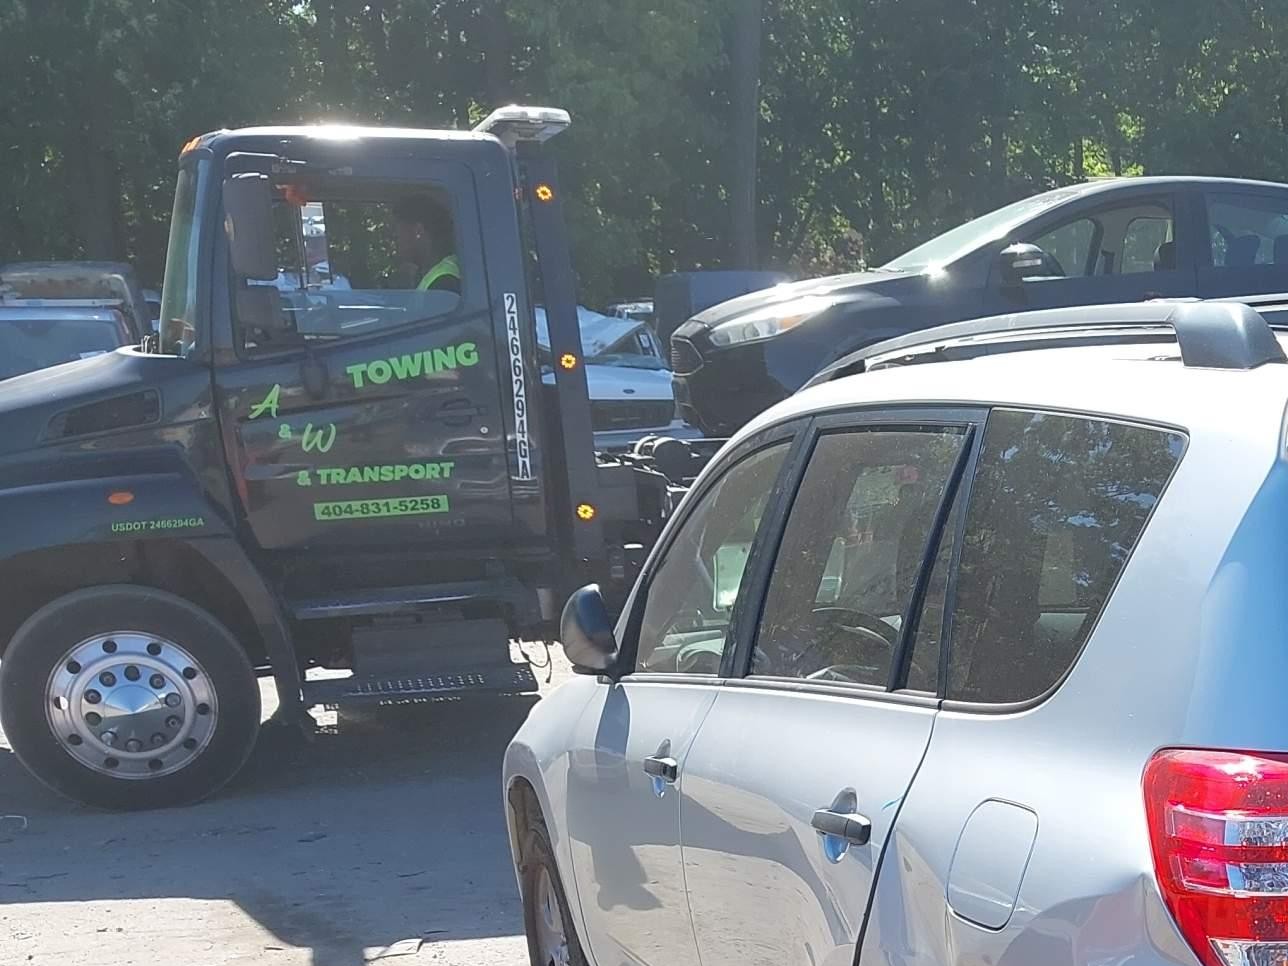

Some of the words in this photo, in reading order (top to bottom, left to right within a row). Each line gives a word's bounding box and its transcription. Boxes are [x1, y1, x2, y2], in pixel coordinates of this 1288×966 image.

[347, 343, 479, 388] TOWING
[506, 294, 531, 479] 2466294GA
[249, 384, 281, 419] A
[278, 424, 292, 440] &
[302, 423, 336, 452] W
[297, 470, 312, 486] &
[317, 462, 454, 485] TRANSPORT
[320, 498, 441, 518] 404-831-5258
[111, 521, 147, 532] USDOT
